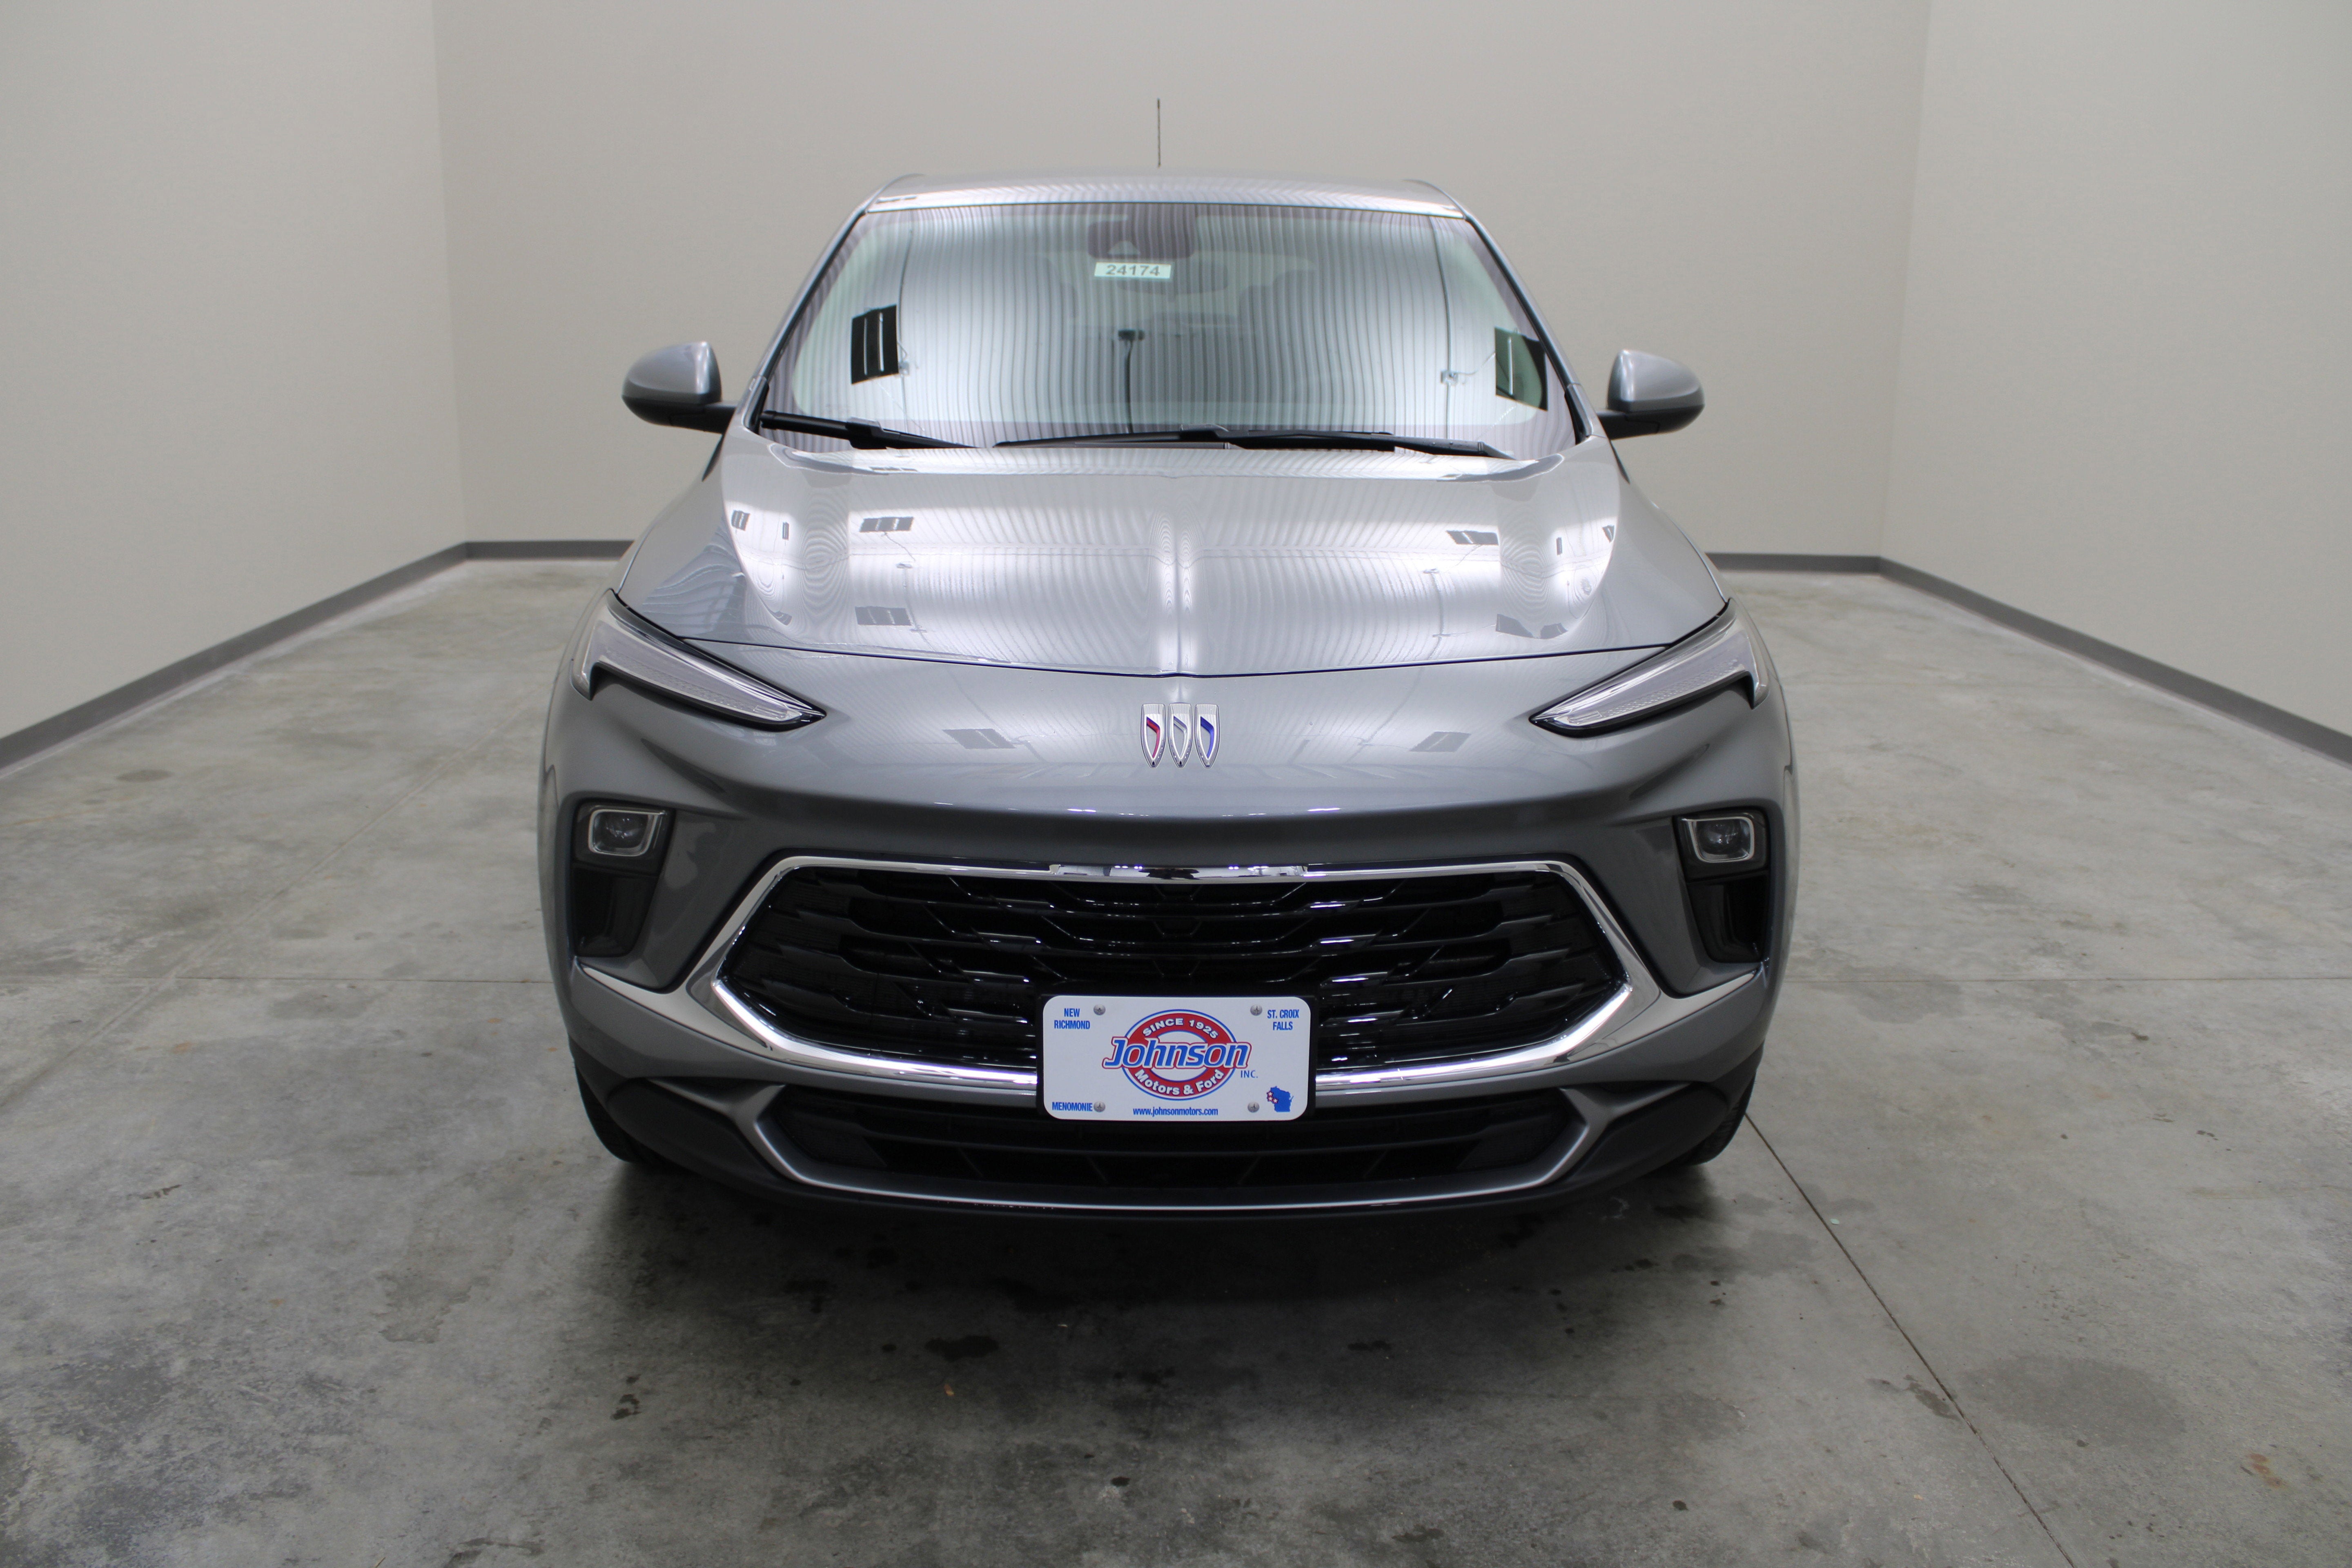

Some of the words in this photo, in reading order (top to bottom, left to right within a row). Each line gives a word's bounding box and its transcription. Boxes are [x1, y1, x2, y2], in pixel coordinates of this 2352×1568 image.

[1106, 264, 1160, 276] 24174
[1064, 1008, 1080, 1017] NEW
[1267, 1010, 1277, 1018] ST.
[1280, 1009, 1299, 1018] CROIX
[1054, 1020, 1090, 1029] RICHMOND
[1143, 1018, 1183, 1037] SINCE
[1189, 1020, 1219, 1039] 1925
[1273, 1021, 1293, 1030] FALLS
[1104, 1038, 1250, 1067] Johnson
[1240, 1070, 1258, 1078] INC.
[1134, 1069, 1180, 1096] Motors
[1183, 1085, 1194, 1095] &
[1195, 1069, 1225, 1092] Ford
[1052, 1102, 1093, 1111] MENOMONIE
[1133, 1107, 1218, 1117] www.johnsonmotors.com
